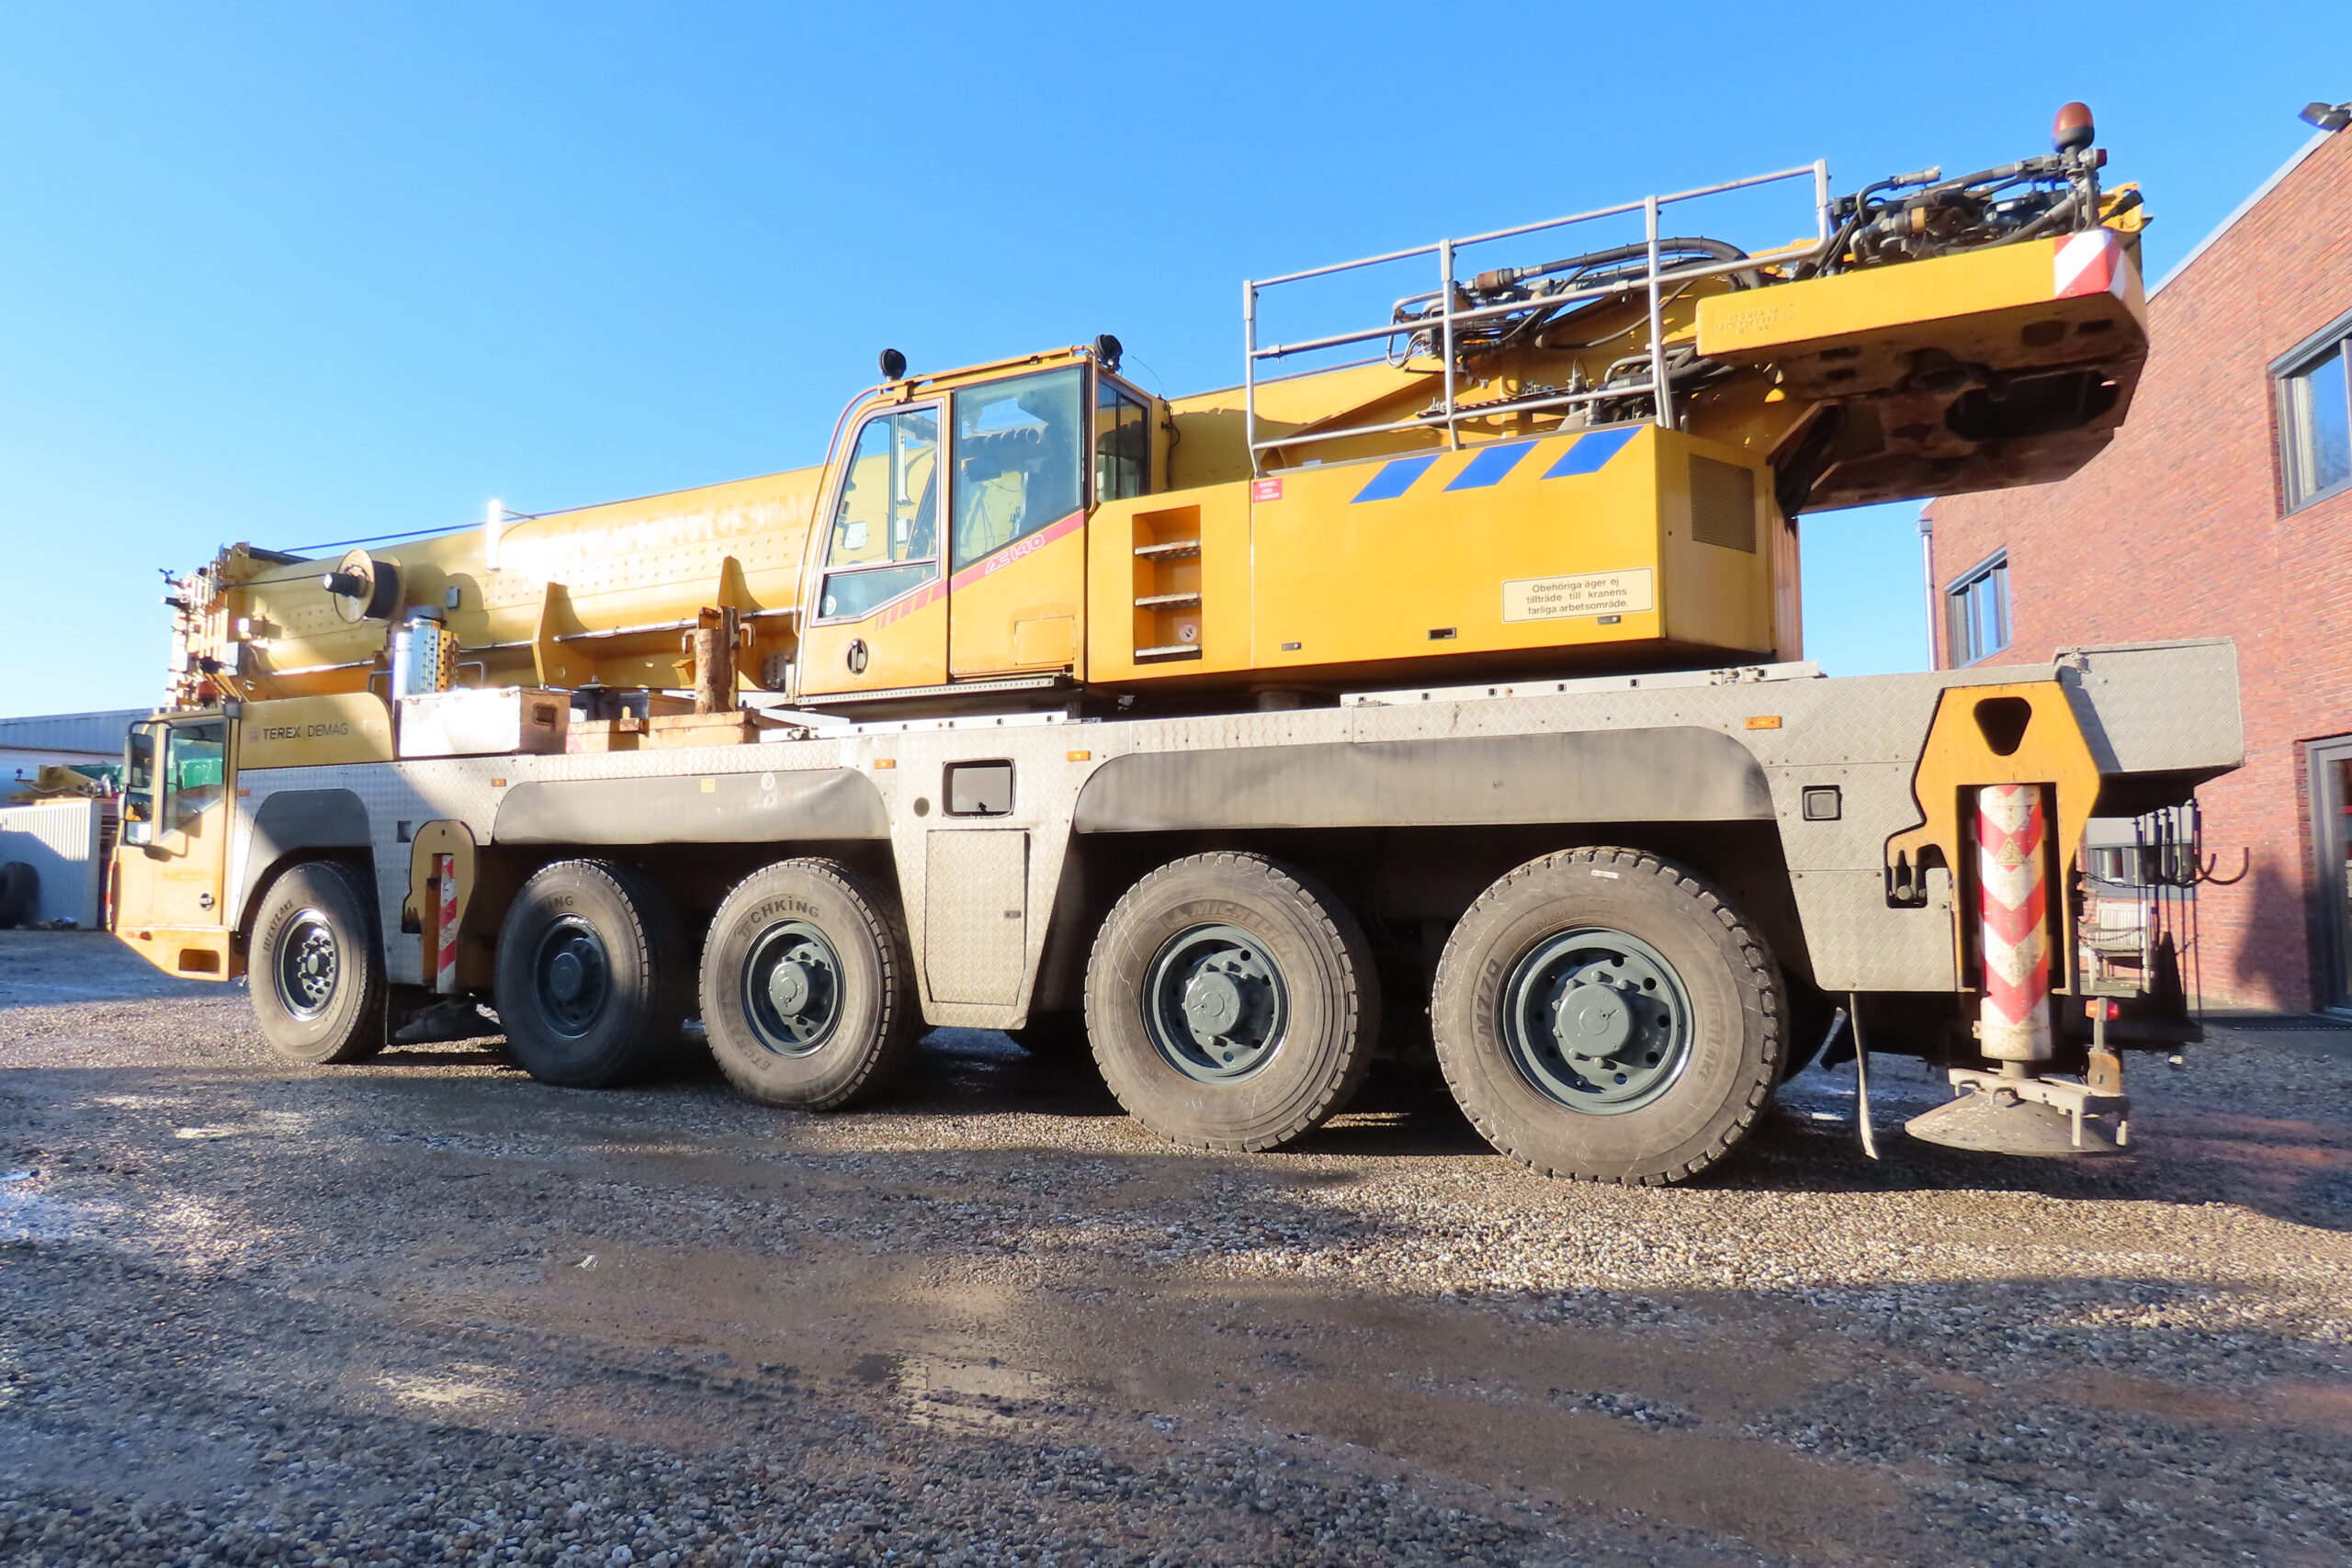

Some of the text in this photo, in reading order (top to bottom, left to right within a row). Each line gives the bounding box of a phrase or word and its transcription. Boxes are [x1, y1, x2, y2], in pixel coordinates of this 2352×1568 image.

[1532, 576, 1620, 593] Obehöriga äger ej
[1526, 588, 1627, 604] tillträde till kranens
[1528, 604, 1557, 615] farliga
[263, 722, 349, 740] TEREX DEMAG
[263, 898, 294, 953] WESTLAKE
